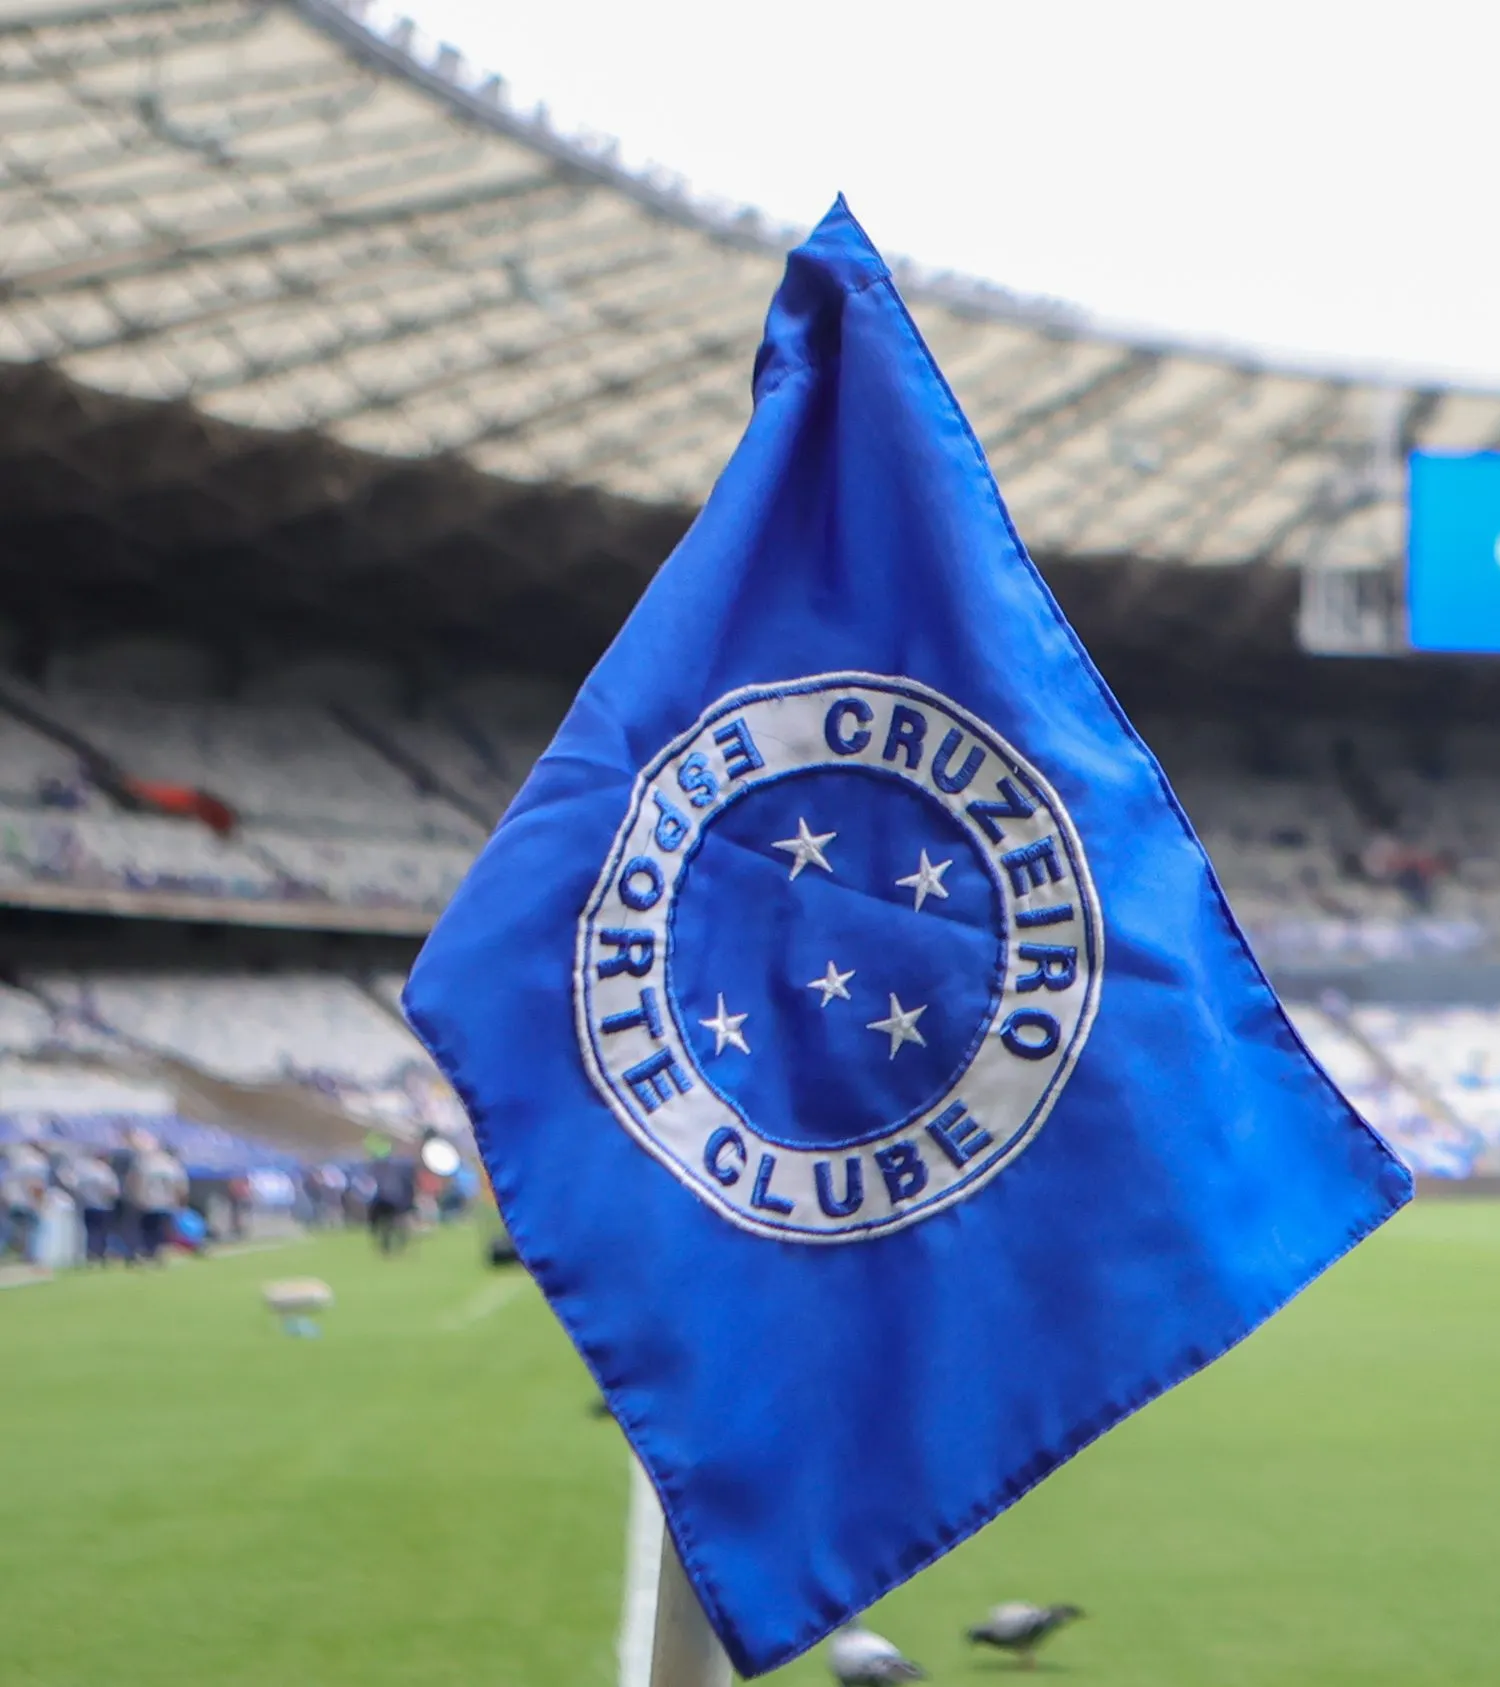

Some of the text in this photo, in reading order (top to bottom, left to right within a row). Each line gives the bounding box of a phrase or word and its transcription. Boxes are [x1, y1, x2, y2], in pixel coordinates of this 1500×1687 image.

[596, 717, 993, 1218] ESPORTE CLUBE
[822, 696, 1078, 1060] CRUZEIRO
